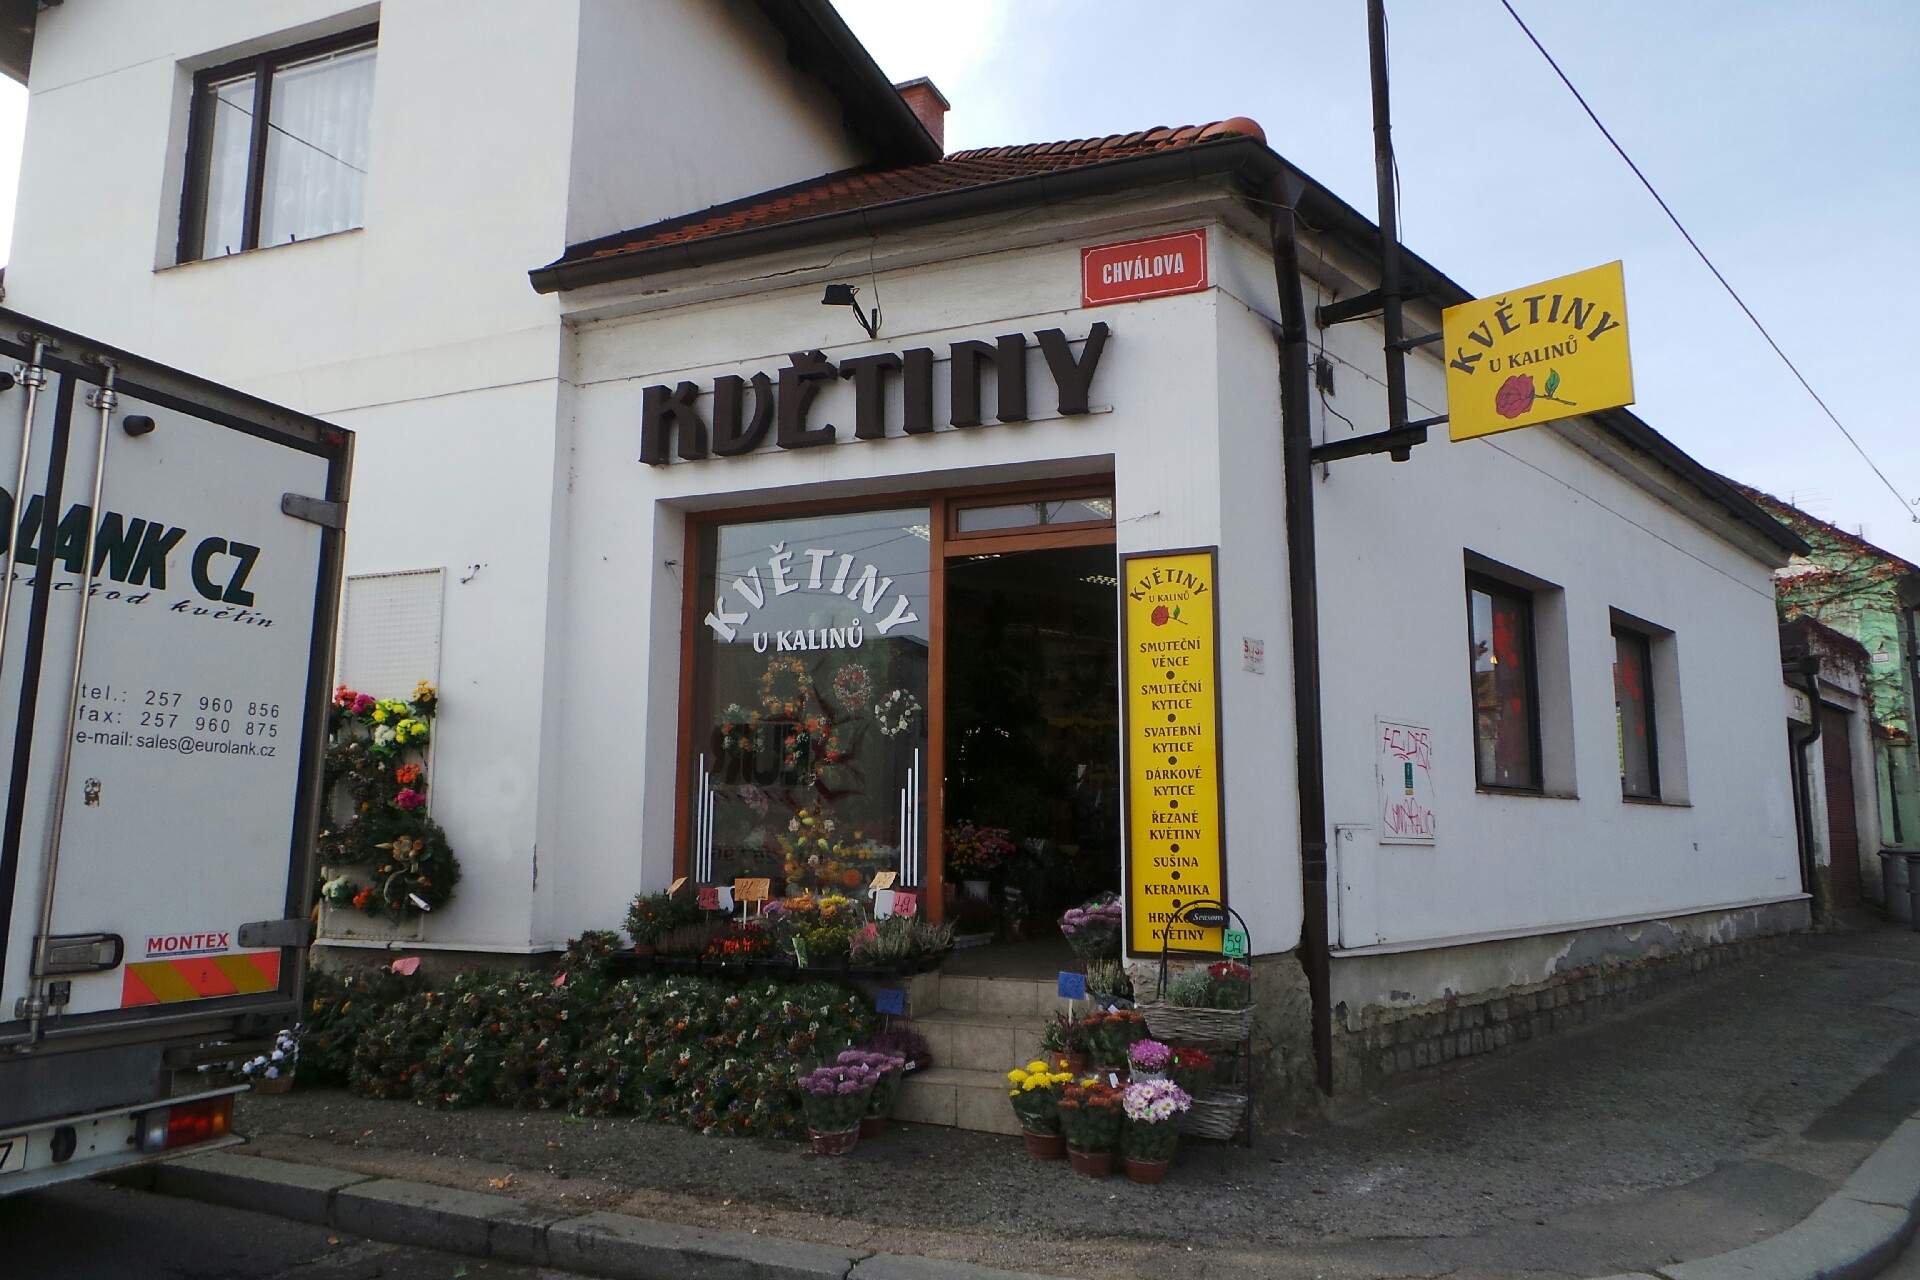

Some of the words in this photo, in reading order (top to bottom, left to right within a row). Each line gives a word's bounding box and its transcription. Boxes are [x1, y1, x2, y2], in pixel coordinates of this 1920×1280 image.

[1102, 252, 1185, 285] CHVÁLOVA
[1449, 294, 1621, 376] KVĚTINY
[1489, 359, 1502, 373] U
[1508, 334, 1579, 369] KALINŮ
[639, 321, 1110, 467] KVĚTINY
[191, 536, 261, 608] CZ
[703, 540, 919, 644] KVĚTINY
[1129, 566, 1209, 602] KVĚTINY
[1148, 594, 1156, 603] U
[1157, 590, 1190, 603] KALINŮ
[752, 631, 769, 653] U
[776, 618, 864, 653] KALINŮ
[1140, 637, 1201, 653] SMUTEČNÍ
[1151, 655, 1190, 668] VĚNCE
[1141, 680, 1202, 696] SMUTEČNÍ
[81, 684, 127, 703] tel.:
[145, 690, 182, 708] 257
[199, 696, 233, 713] 960
[248, 702, 280, 718] 856
[1151, 699, 1193, 711] KYTICE
[78, 705, 122, 724] fax:
[140, 711, 178, 728] 257
[195, 717, 230, 733] 960
[245, 721, 278, 737] 875
[1144, 723, 1202, 738] SVATEBNÍ
[76, 731, 132, 747] e-mail:
[136, 735, 276, 758] sales@eurolank.cz
[1152, 742, 1194, 753] KYTICE
[1146, 766, 1203, 781] DÁRKOVÉ
[1153, 785, 1195, 796] KYTICE
[1152, 810, 1199, 824] ŘEZANÉ
[1150, 827, 1202, 840] KVĚTINY
[1153, 854, 1199, 868] SUŠINA
[1144, 884, 1210, 895] KERAMIKA
[1192, 912, 1224, 921] Seasons
[1152, 926, 1205, 941] KVĚTINY
[147, 932, 229, 952] MONTEX
